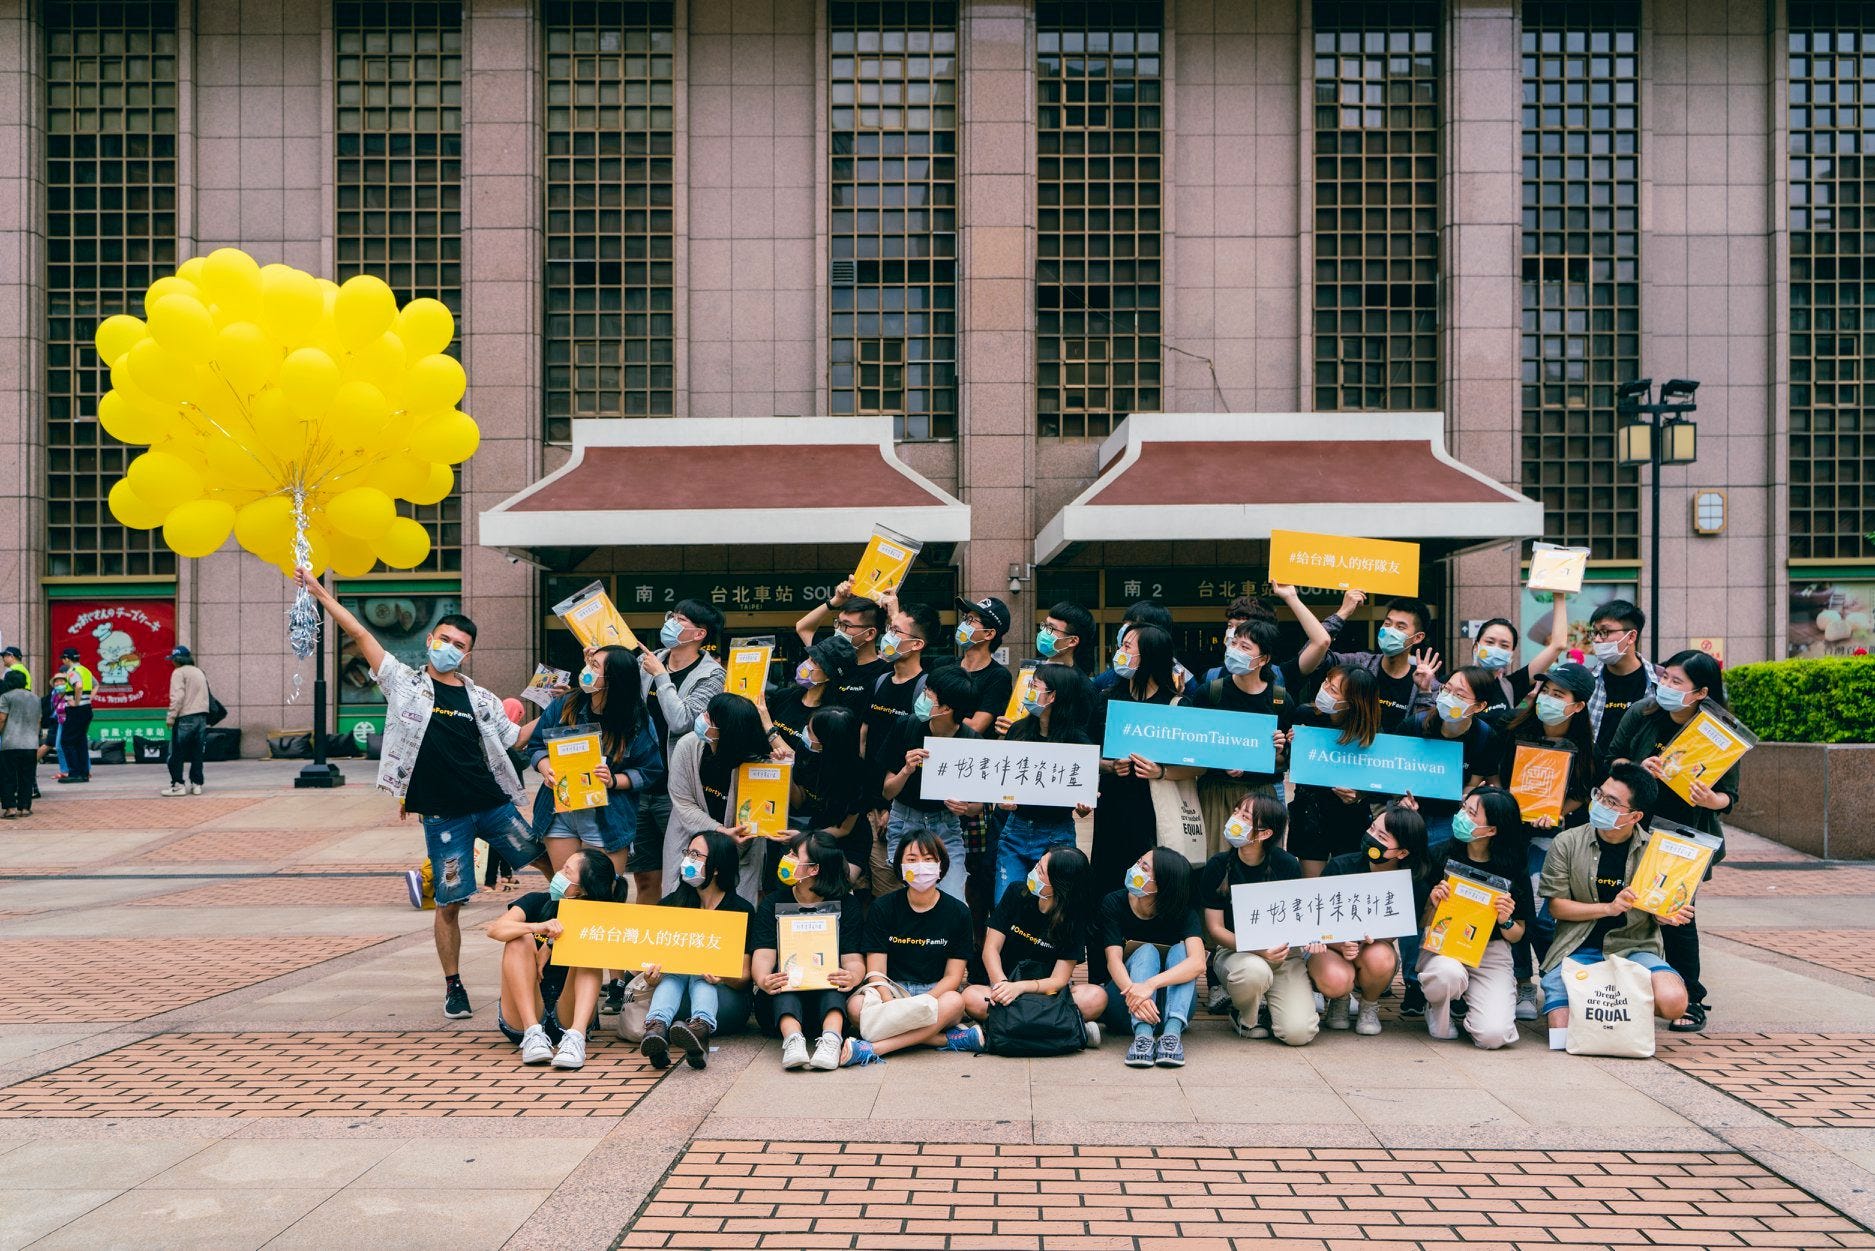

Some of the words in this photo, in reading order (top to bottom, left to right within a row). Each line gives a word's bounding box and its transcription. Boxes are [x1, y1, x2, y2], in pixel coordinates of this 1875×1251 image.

[1289, 551, 1400, 575] #給台灣人的好隊友
[635, 585, 654, 602] 南
[664, 588, 675, 602] 2
[710, 585, 794, 603] 台北車站
[1124, 580, 1142, 597] 南
[1152, 583, 1163, 598] 2
[1123, 722, 1260, 748] #AGiftFromTaiwan
[1308, 748, 1446, 775] #AGiftFromTaiwan
[1182, 823, 1203, 836] EQUAL
[579, 924, 722, 951] #給台灣人的好隊友
[888, 935, 948, 947] #OneFortyFamily
[1585, 1007, 1632, 1023] EQUAL
